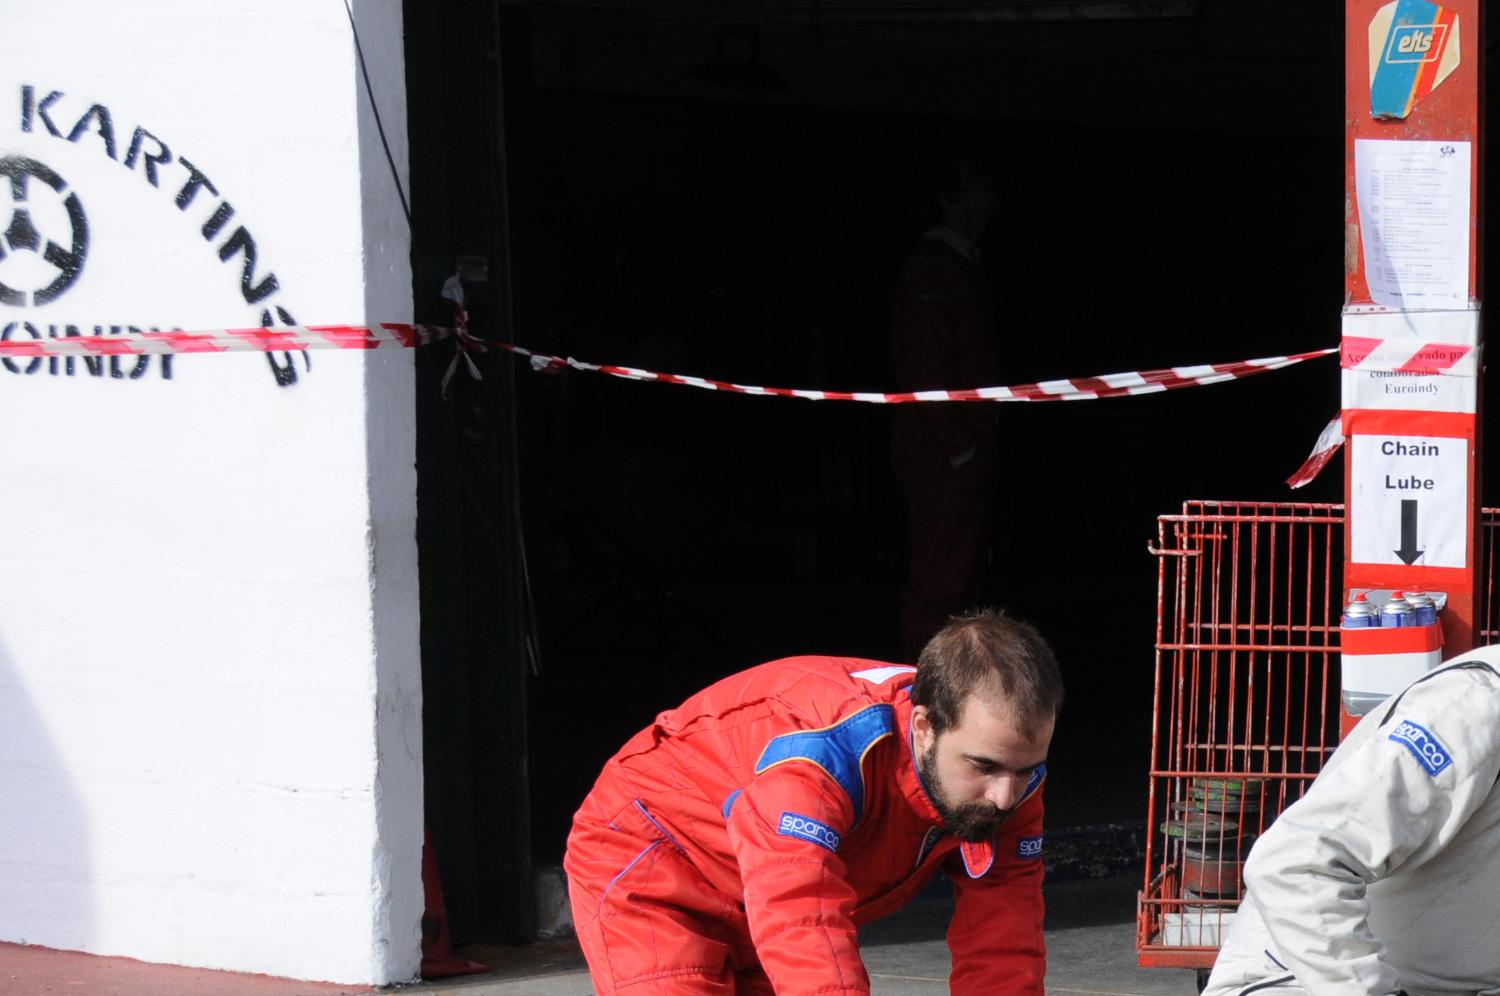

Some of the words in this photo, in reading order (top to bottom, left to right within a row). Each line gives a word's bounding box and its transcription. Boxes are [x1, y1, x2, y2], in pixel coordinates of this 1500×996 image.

[19, 84, 312, 387] KARTING
[1385, 383, 1440, 396] Euroindy
[1380, 441, 1440, 457] Chain
[1385, 475, 1435, 490] Lube
[1394, 723, 1445, 767] sparco
[781, 815, 839, 848] sparco
